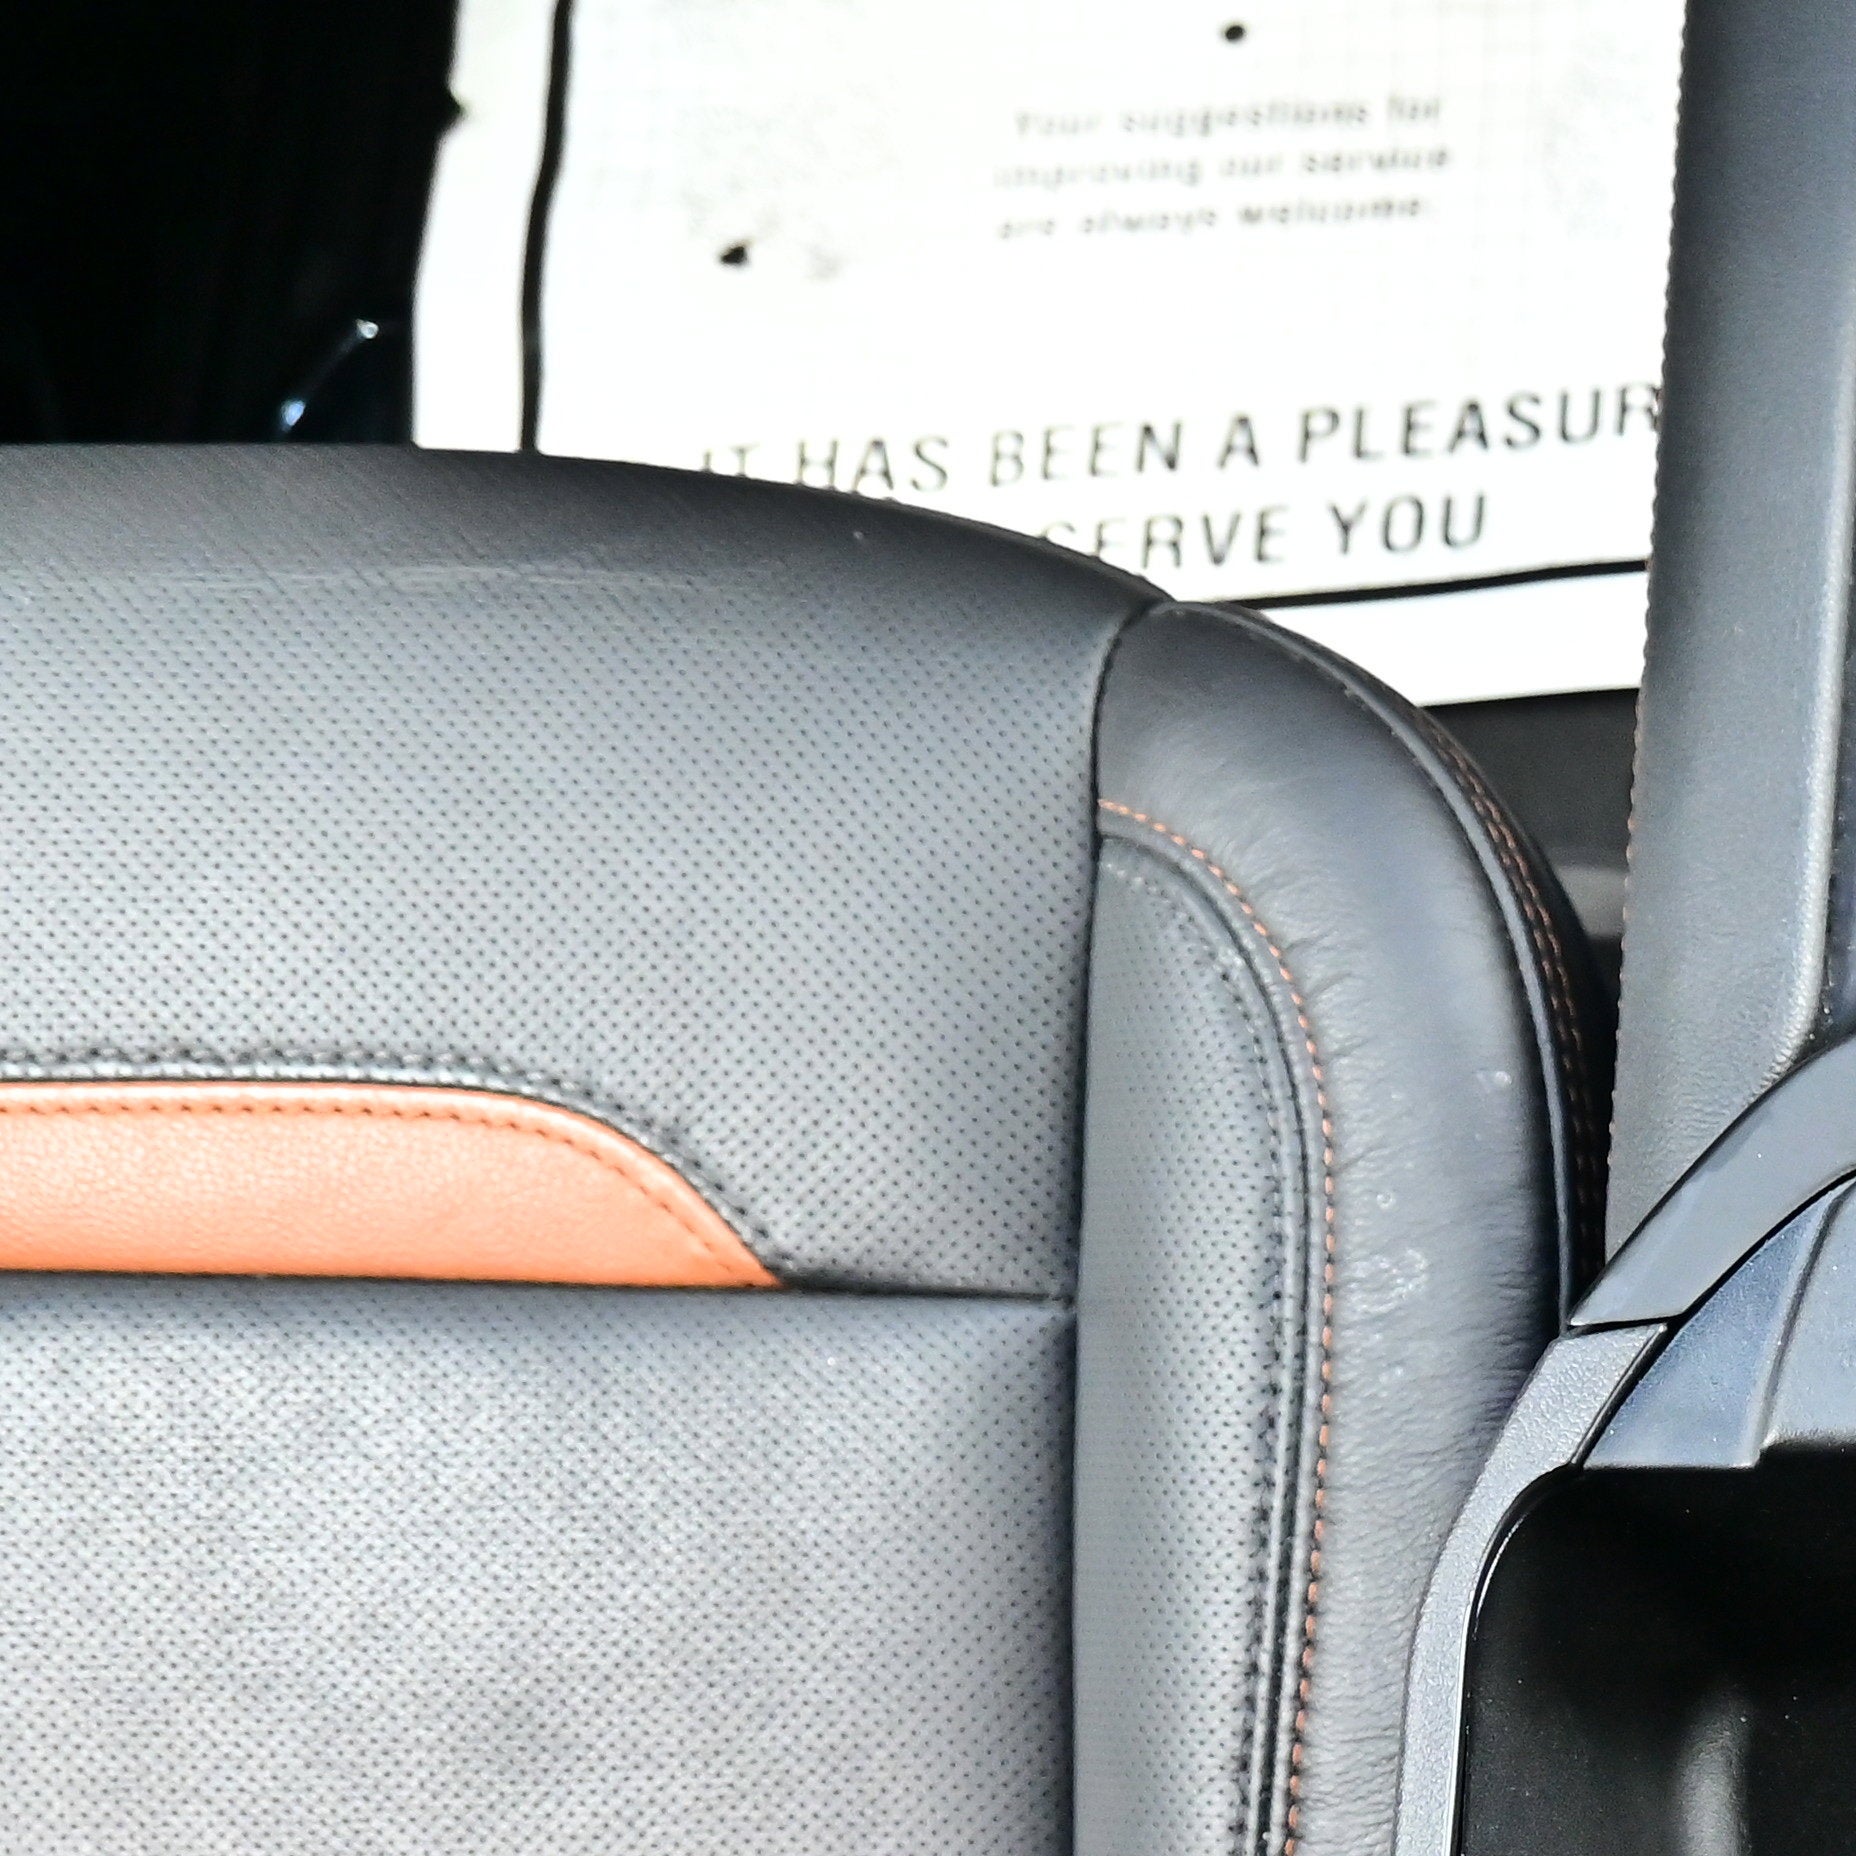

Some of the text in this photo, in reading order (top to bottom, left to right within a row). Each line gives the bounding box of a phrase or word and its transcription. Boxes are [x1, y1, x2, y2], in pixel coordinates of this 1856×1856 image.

[797, 436, 950, 493] HAS
[990, 421, 1183, 488] BEEN
[1217, 414, 1260, 469] A
[1299, 382, 1661, 464] PLEASUR
[1328, 491, 1487, 556] YOU
